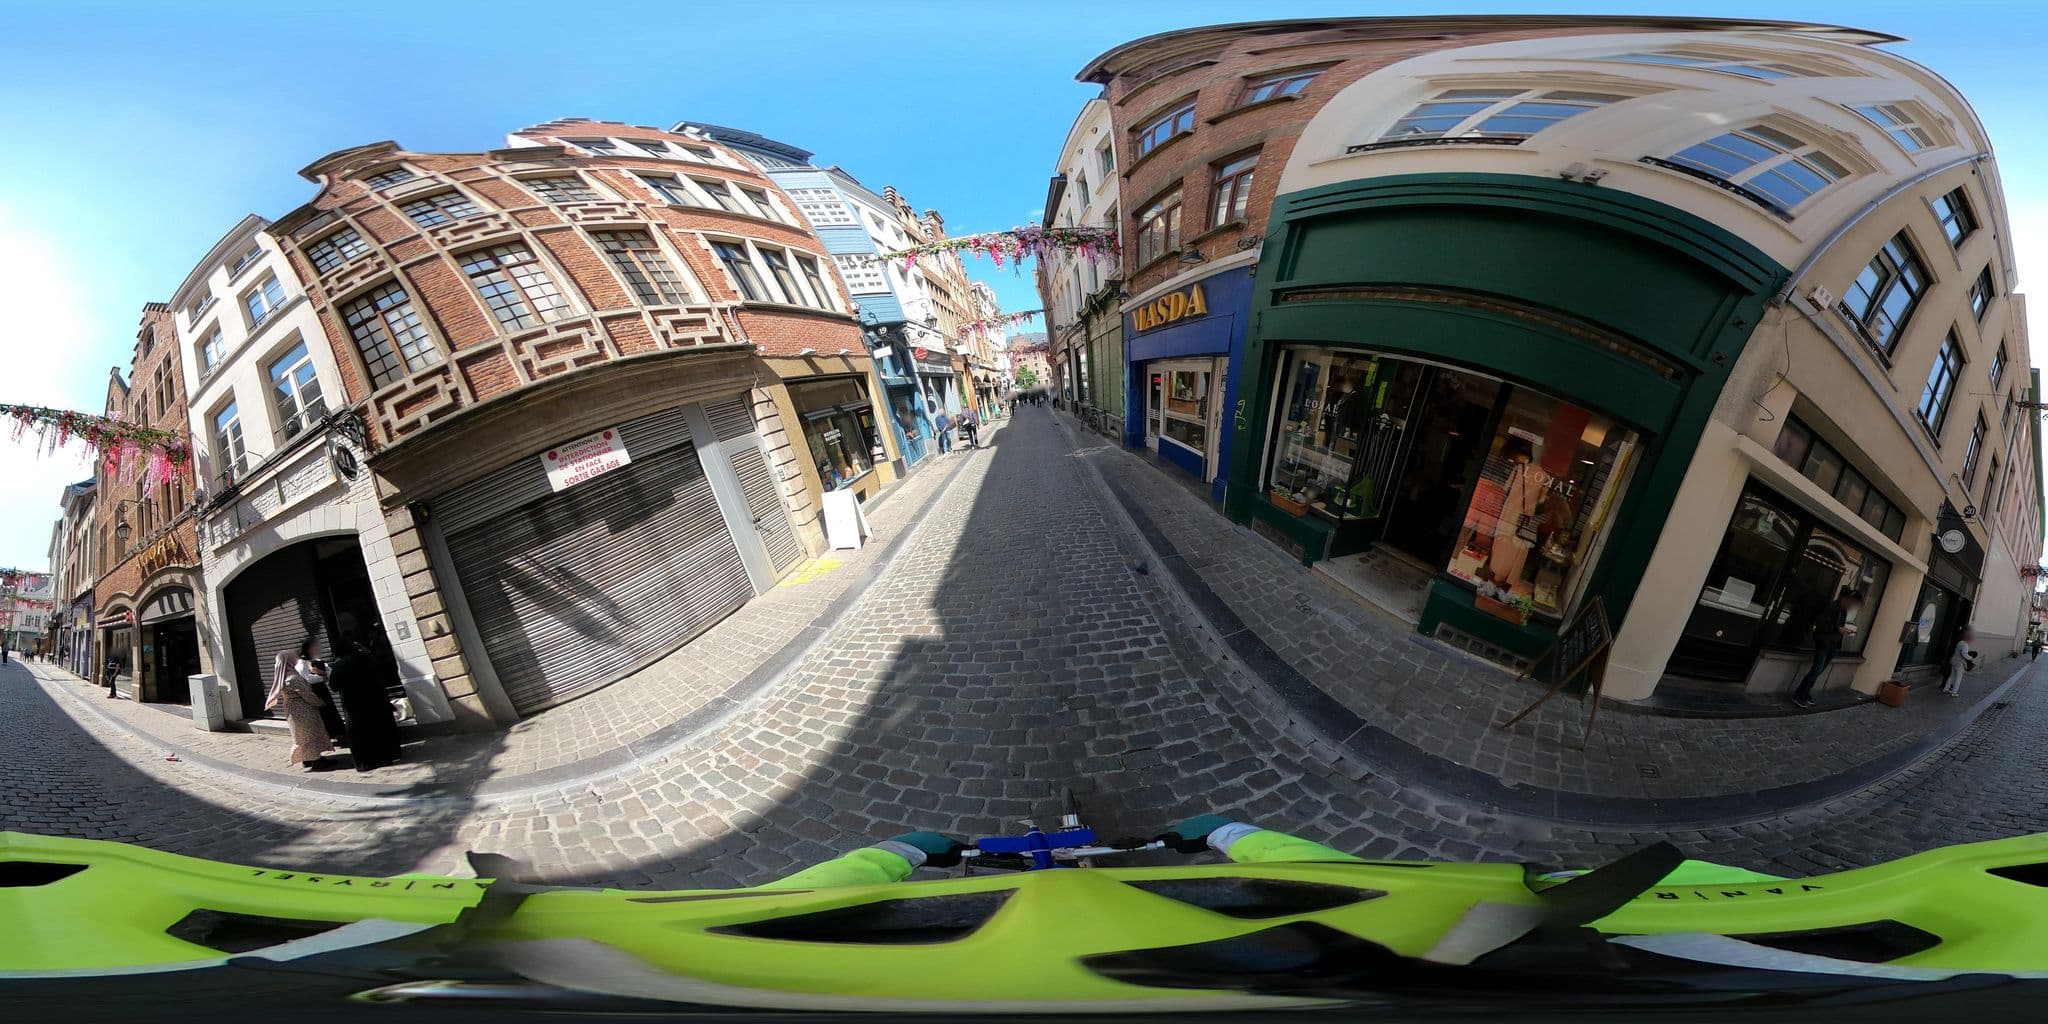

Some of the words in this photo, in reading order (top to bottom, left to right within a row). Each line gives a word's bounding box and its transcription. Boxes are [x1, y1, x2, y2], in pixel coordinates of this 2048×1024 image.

[559, 441, 608, 462] INTERDICTION
[562, 439, 592, 453] ATTENTION
[571, 446, 613, 466] STATIONNER
[564, 471, 590, 486] SORTIE
[591, 460, 620, 475] GARAGE
[575, 465, 585, 473] EN
[586, 458, 602, 469] FACE
[1965, 506, 1975, 514] 20
